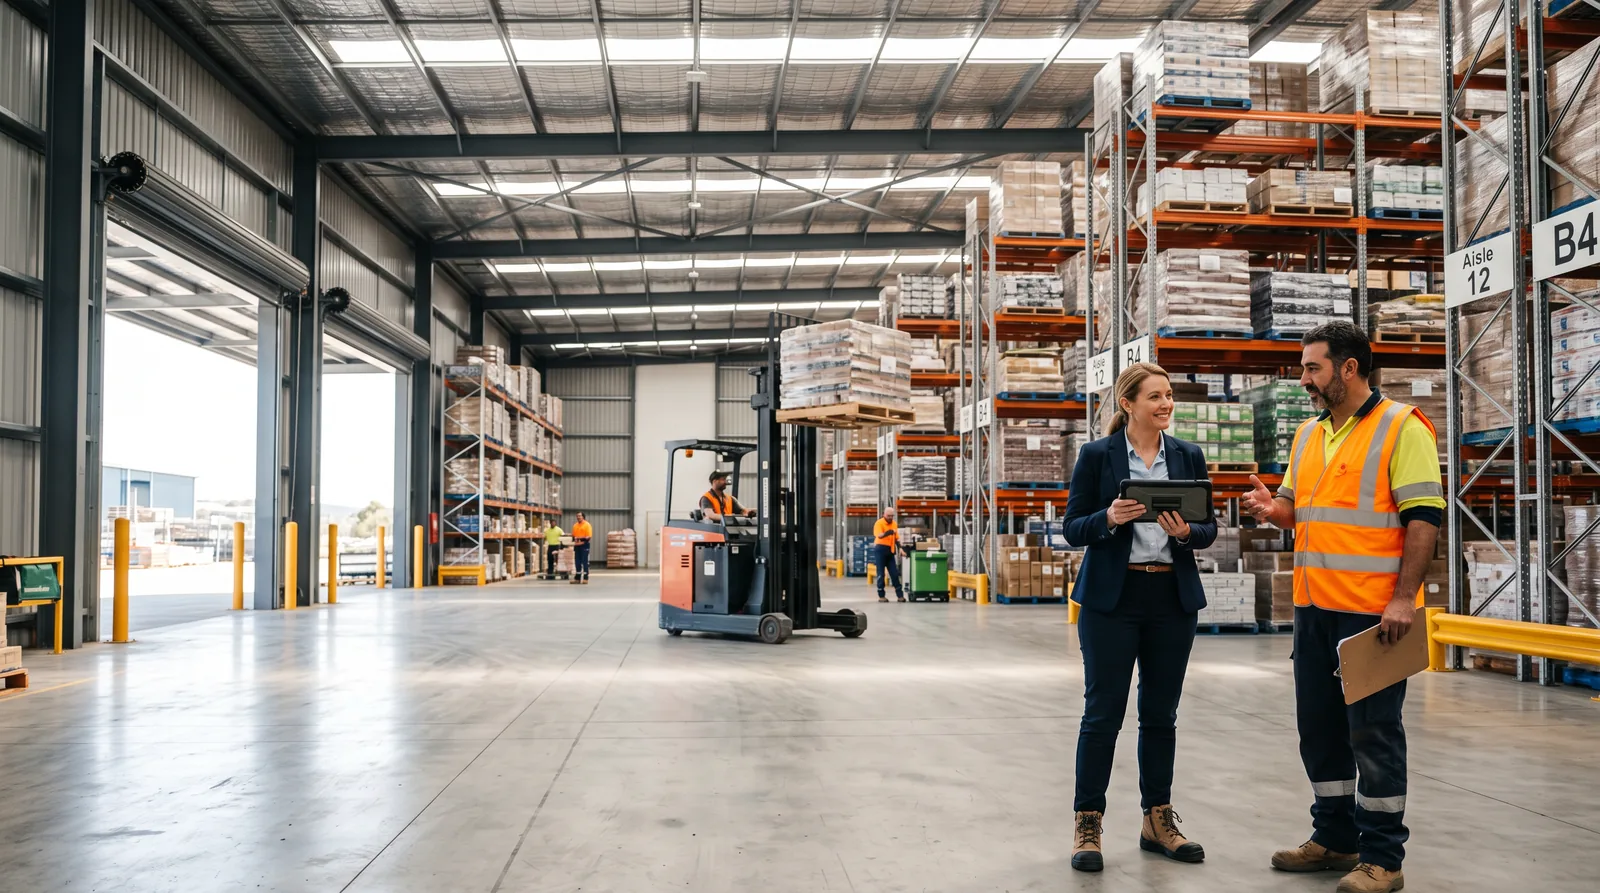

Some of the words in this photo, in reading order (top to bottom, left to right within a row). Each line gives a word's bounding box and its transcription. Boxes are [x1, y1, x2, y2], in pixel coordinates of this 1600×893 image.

[1554, 212, 1598, 266] B4
[1463, 247, 1494, 269] Aisle
[1467, 267, 1491, 296] 12
[1095, 369, 1105, 387] 12
